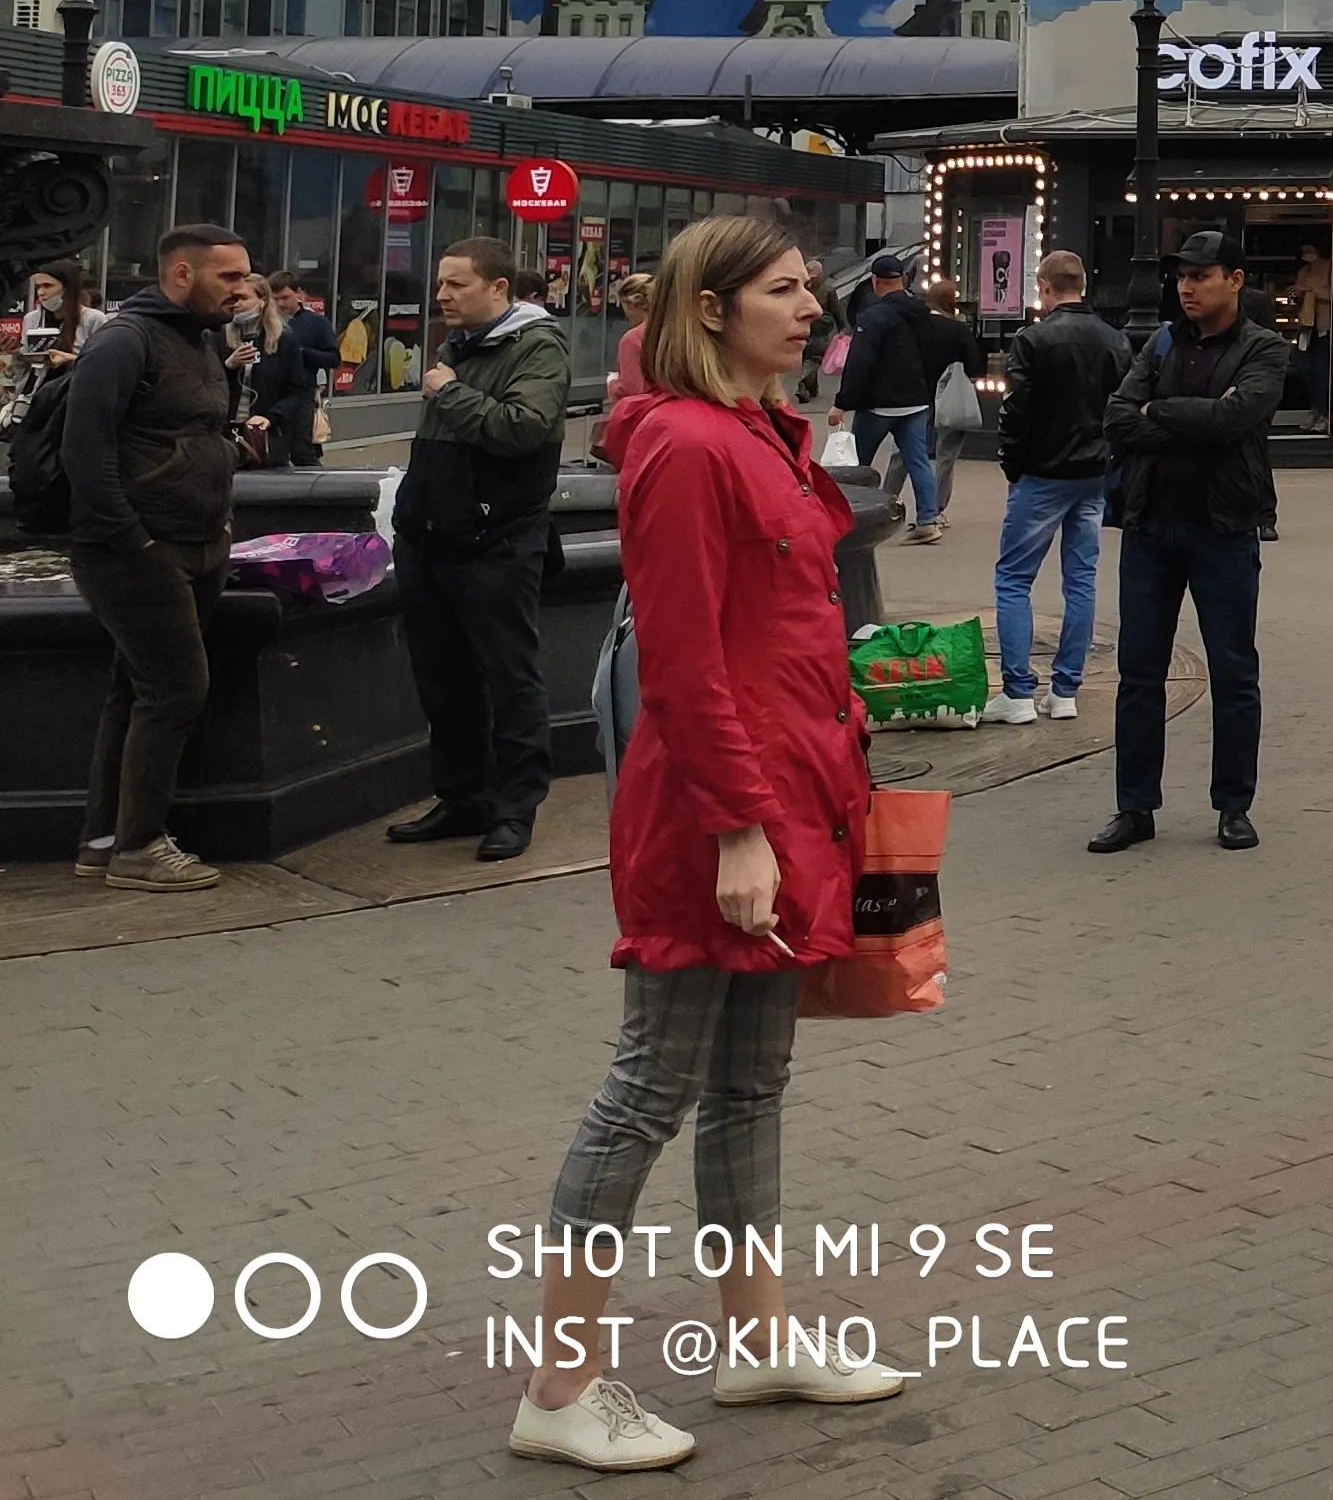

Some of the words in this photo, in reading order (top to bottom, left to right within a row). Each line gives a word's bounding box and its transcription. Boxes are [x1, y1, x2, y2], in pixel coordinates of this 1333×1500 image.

[106, 67, 133, 84] PIZZA
[1157, 31, 1322, 90] cofix
[190, 65, 304, 136] ПИЦЦА
